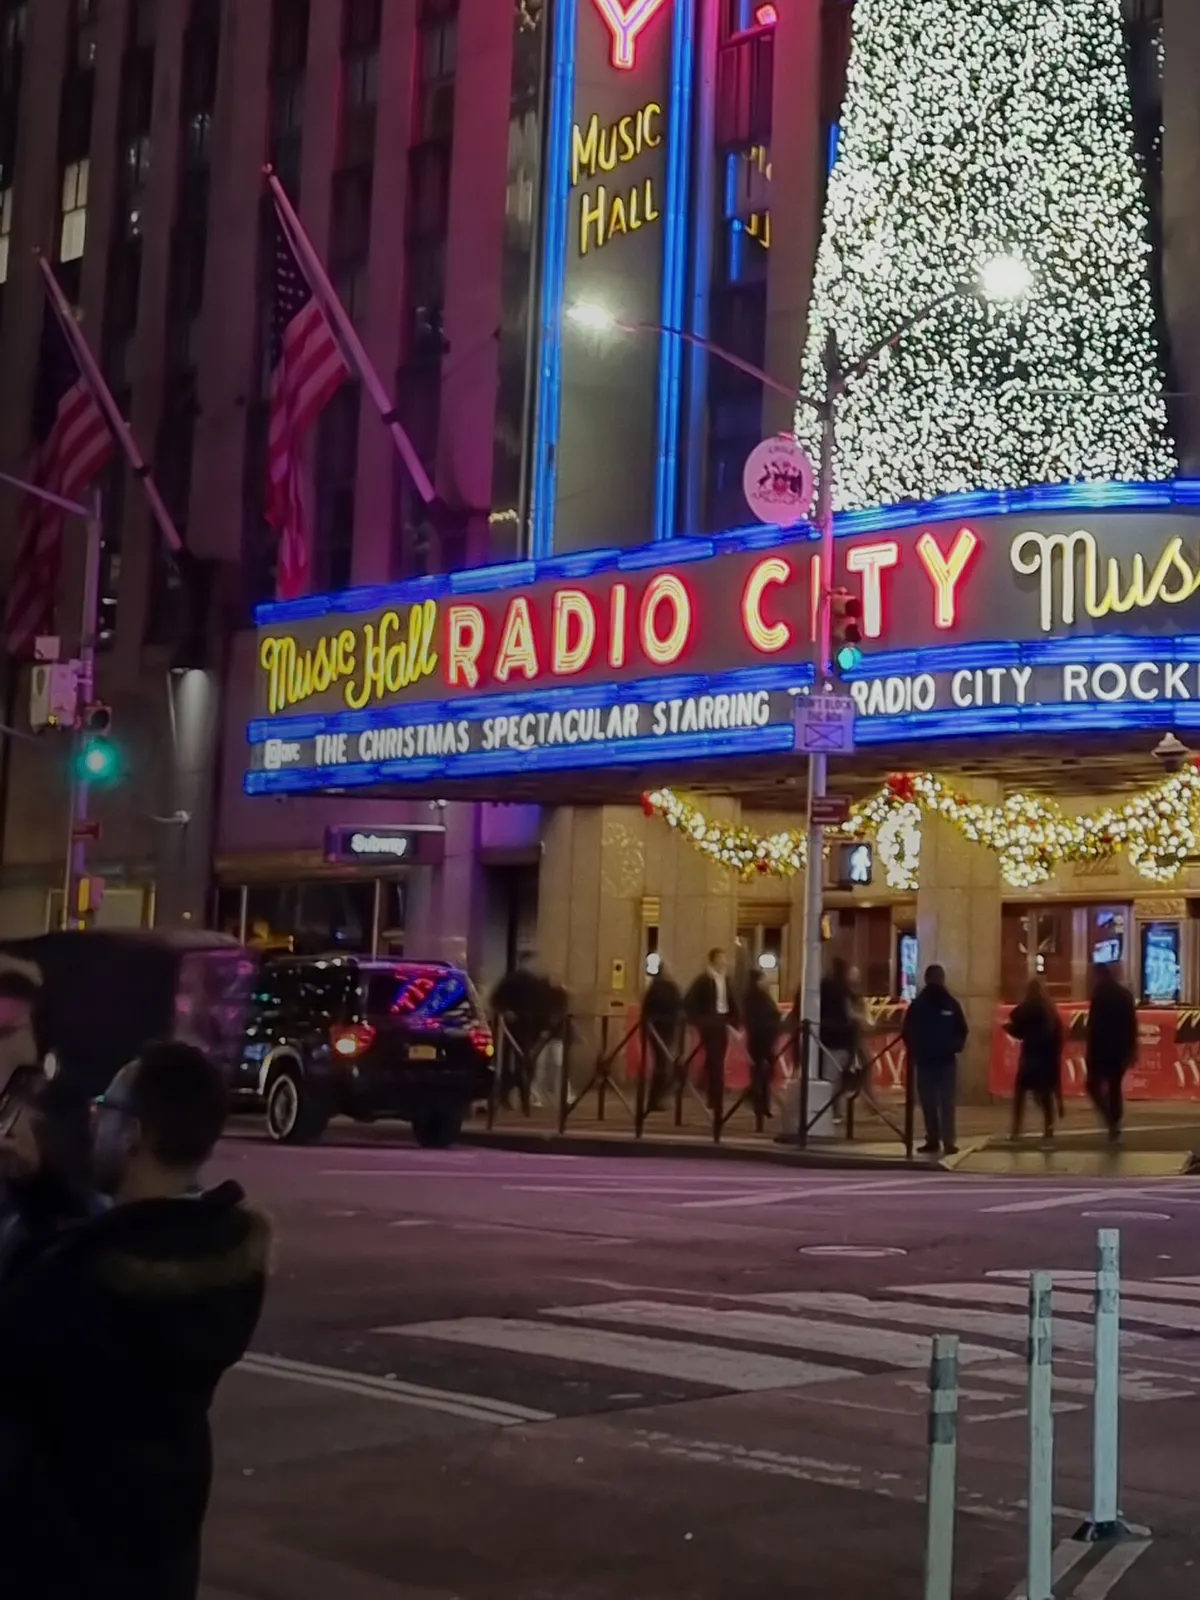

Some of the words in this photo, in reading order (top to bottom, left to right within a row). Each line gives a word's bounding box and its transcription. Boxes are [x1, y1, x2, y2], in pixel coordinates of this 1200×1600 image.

[572, 103, 661, 185] MUSIC
[580, 178, 659, 254] HALL
[346, 599, 437, 710] Hall
[446, 573, 690, 688] RADIO
[315, 730, 348, 766] THE
[358, 720, 470, 760] CHRISTMAS
[482, 706, 640, 749] SPECTACULAR
[652, 691, 770, 735] STARRING
[850, 678, 935, 716] RADIO
[951, 667, 1034, 705] CITY
[350, 833, 407, 856] Subway
